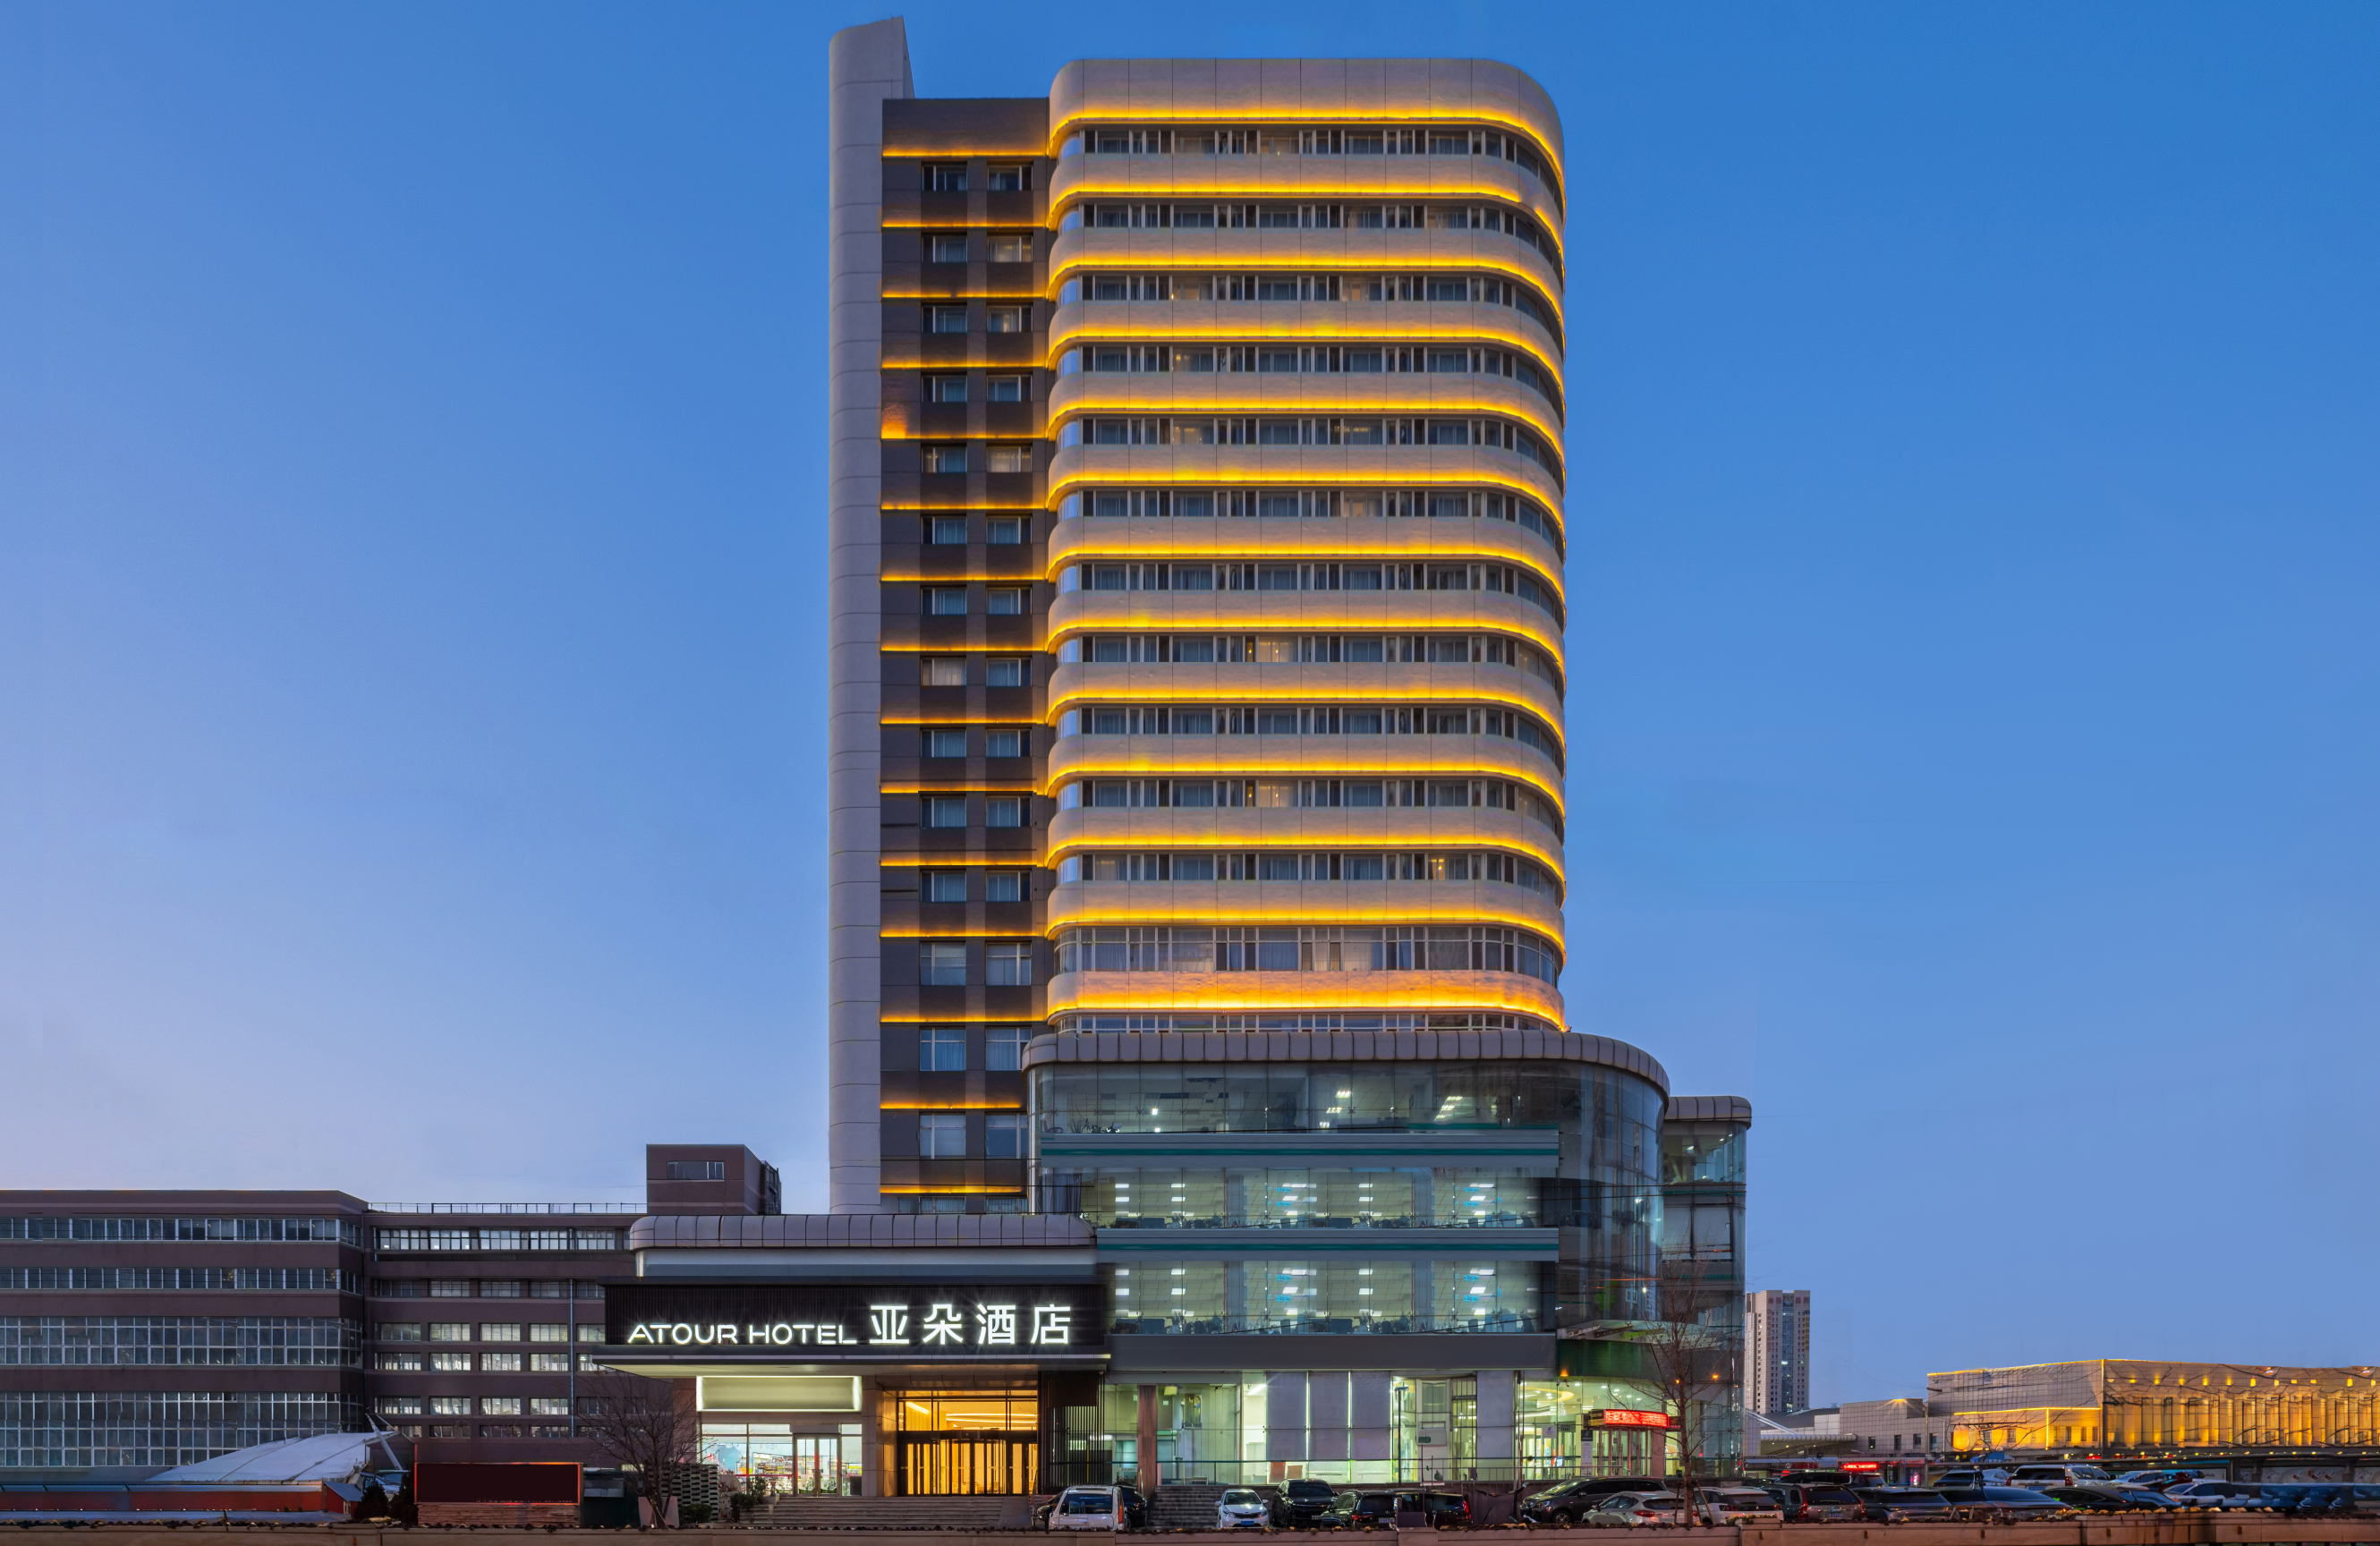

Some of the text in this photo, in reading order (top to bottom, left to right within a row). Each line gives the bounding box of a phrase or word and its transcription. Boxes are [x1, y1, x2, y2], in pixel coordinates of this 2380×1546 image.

[627, 1323, 857, 1345] ATOUR HOTEL
[869, 1304, 1071, 1345] 亚朵酒店
